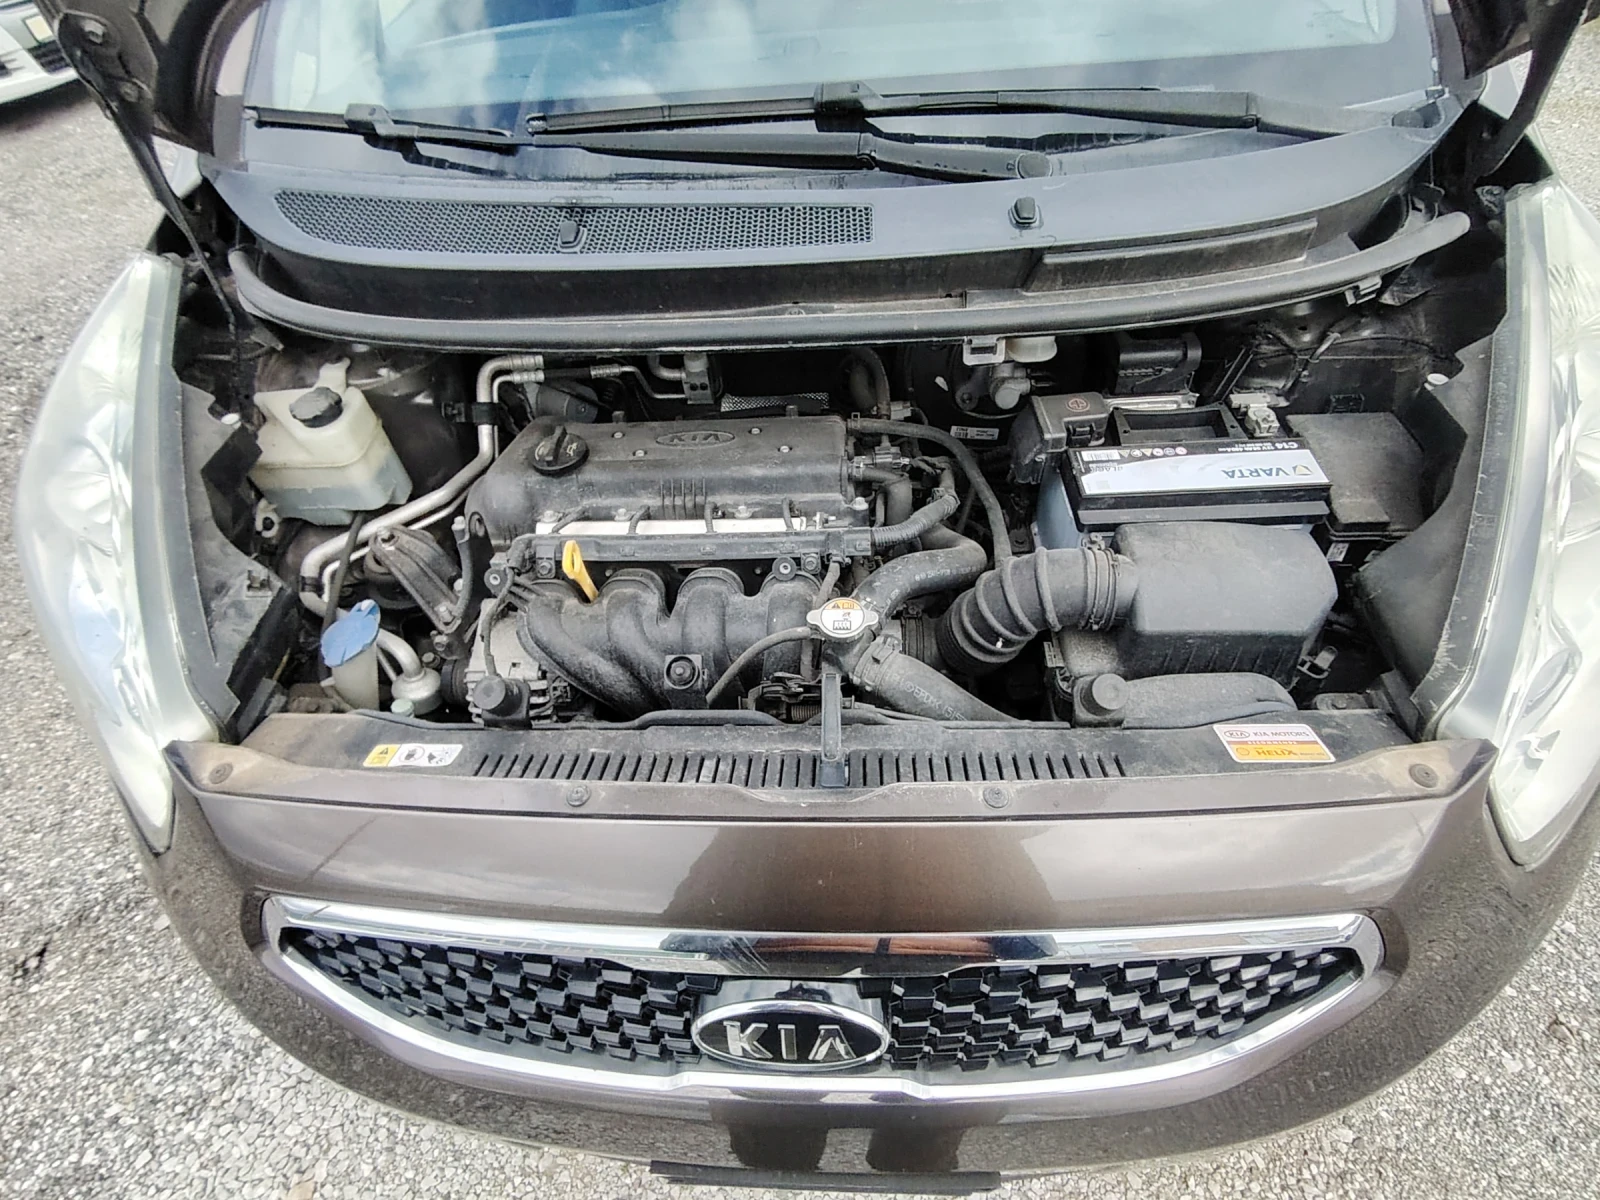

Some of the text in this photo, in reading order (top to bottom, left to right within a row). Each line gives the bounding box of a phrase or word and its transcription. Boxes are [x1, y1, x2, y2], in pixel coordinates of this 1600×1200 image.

[669, 433, 721, 443] KIA
[1274, 441, 1299, 450] C14
[1220, 466, 1291, 479] VARTA
[1255, 749, 1299, 757] HELIX
[723, 1020, 857, 1062] KIA
